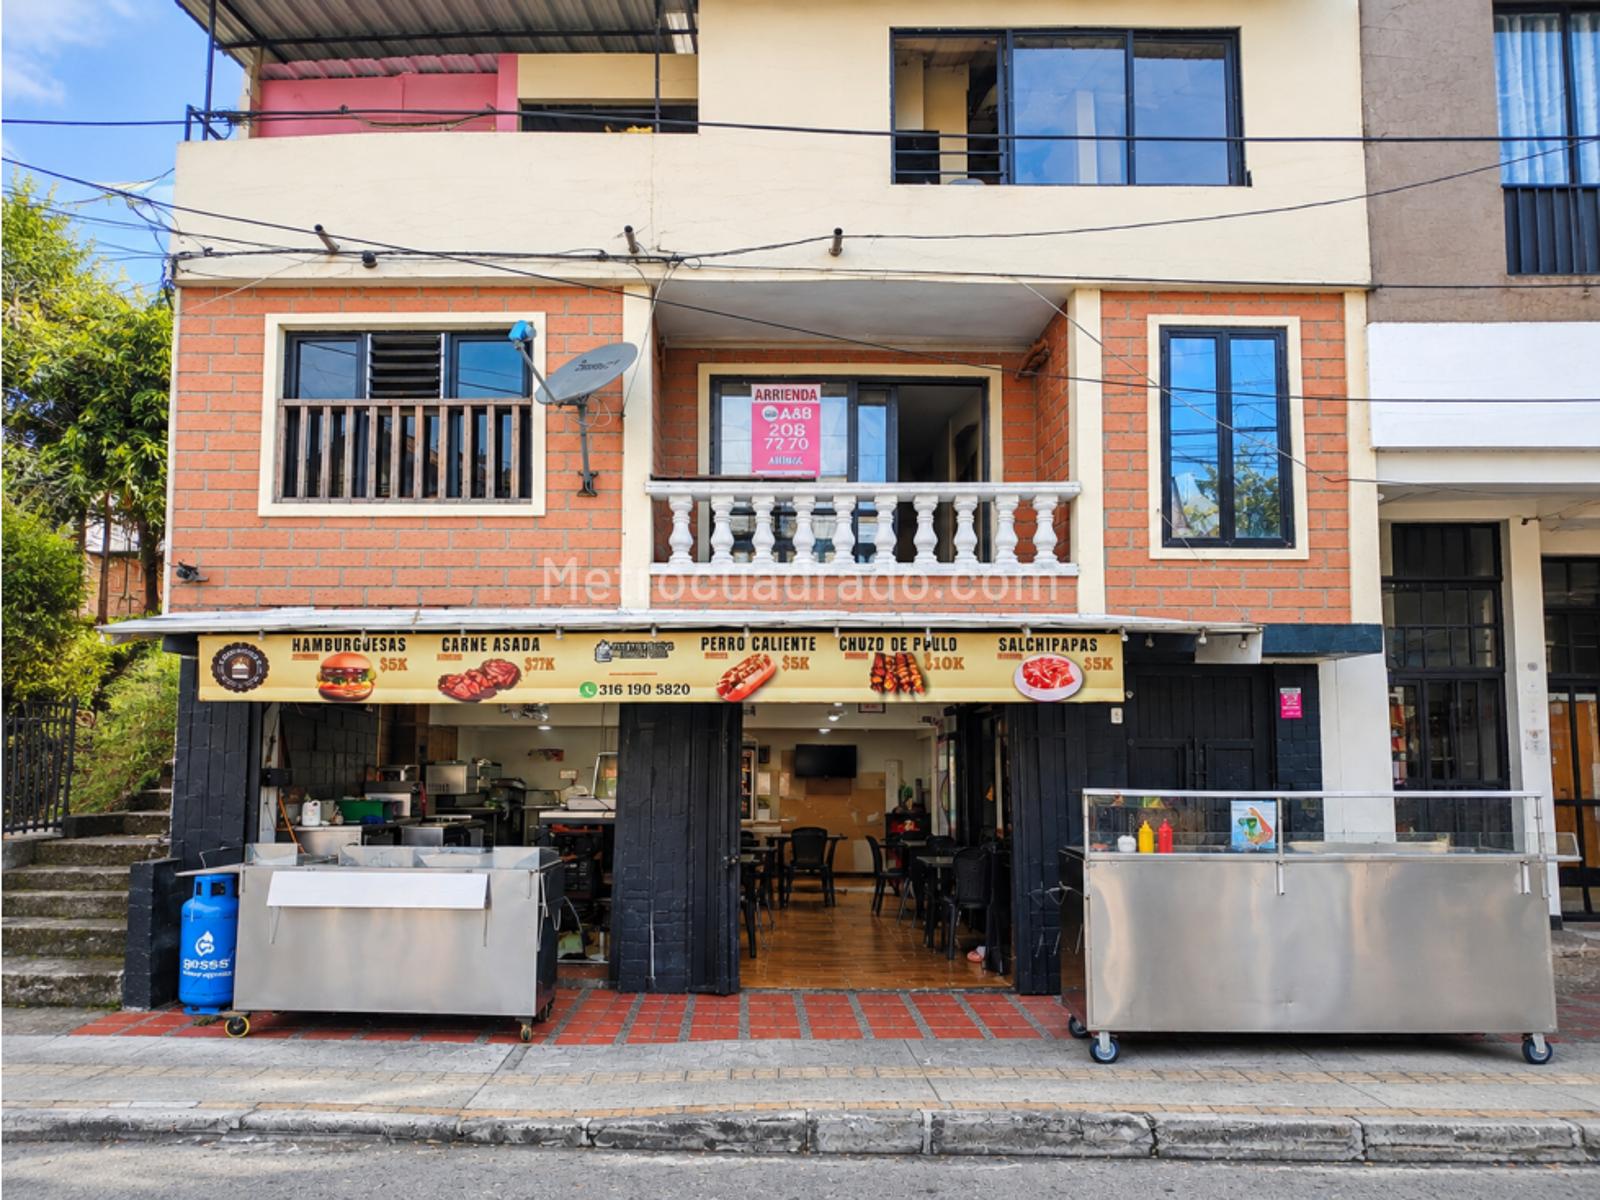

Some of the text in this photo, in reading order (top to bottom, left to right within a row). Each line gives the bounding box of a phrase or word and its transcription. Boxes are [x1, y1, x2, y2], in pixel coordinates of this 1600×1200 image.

[755, 388, 818, 400] ARRIENDA
[292, 638, 406, 652] HAMBURGUESAS
[442, 637, 541, 652] CARNE ASADA
[701, 636, 816, 651] PERRO CALIENTE
[839, 636, 884, 652] CHUZO
[891, 636, 908, 651] DE
[999, 637, 1098, 652] SALCHIPAPAS
[380, 657, 408, 672] $5K
[782, 655, 809, 671] $5K
[1084, 656, 1113, 671] $5K
[599, 683, 690, 695] 316 190 5820
